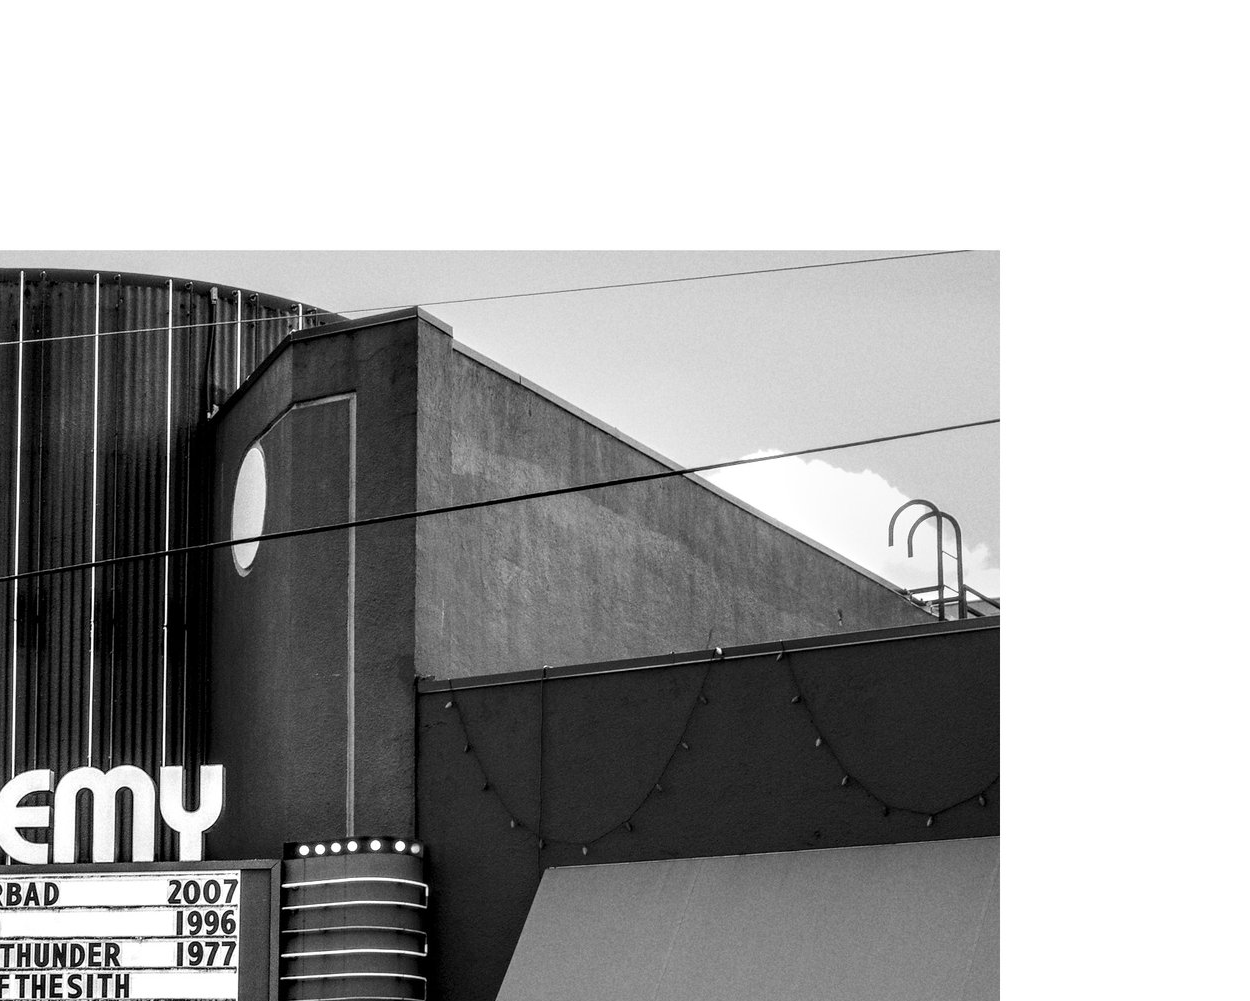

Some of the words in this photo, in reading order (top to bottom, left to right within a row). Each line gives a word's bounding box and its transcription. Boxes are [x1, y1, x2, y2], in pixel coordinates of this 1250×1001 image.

[167, 878, 239, 905] 2007
[175, 909, 237, 936] 1996
[0, 942, 121, 968] THUNDER
[175, 940, 238, 967] 1977
